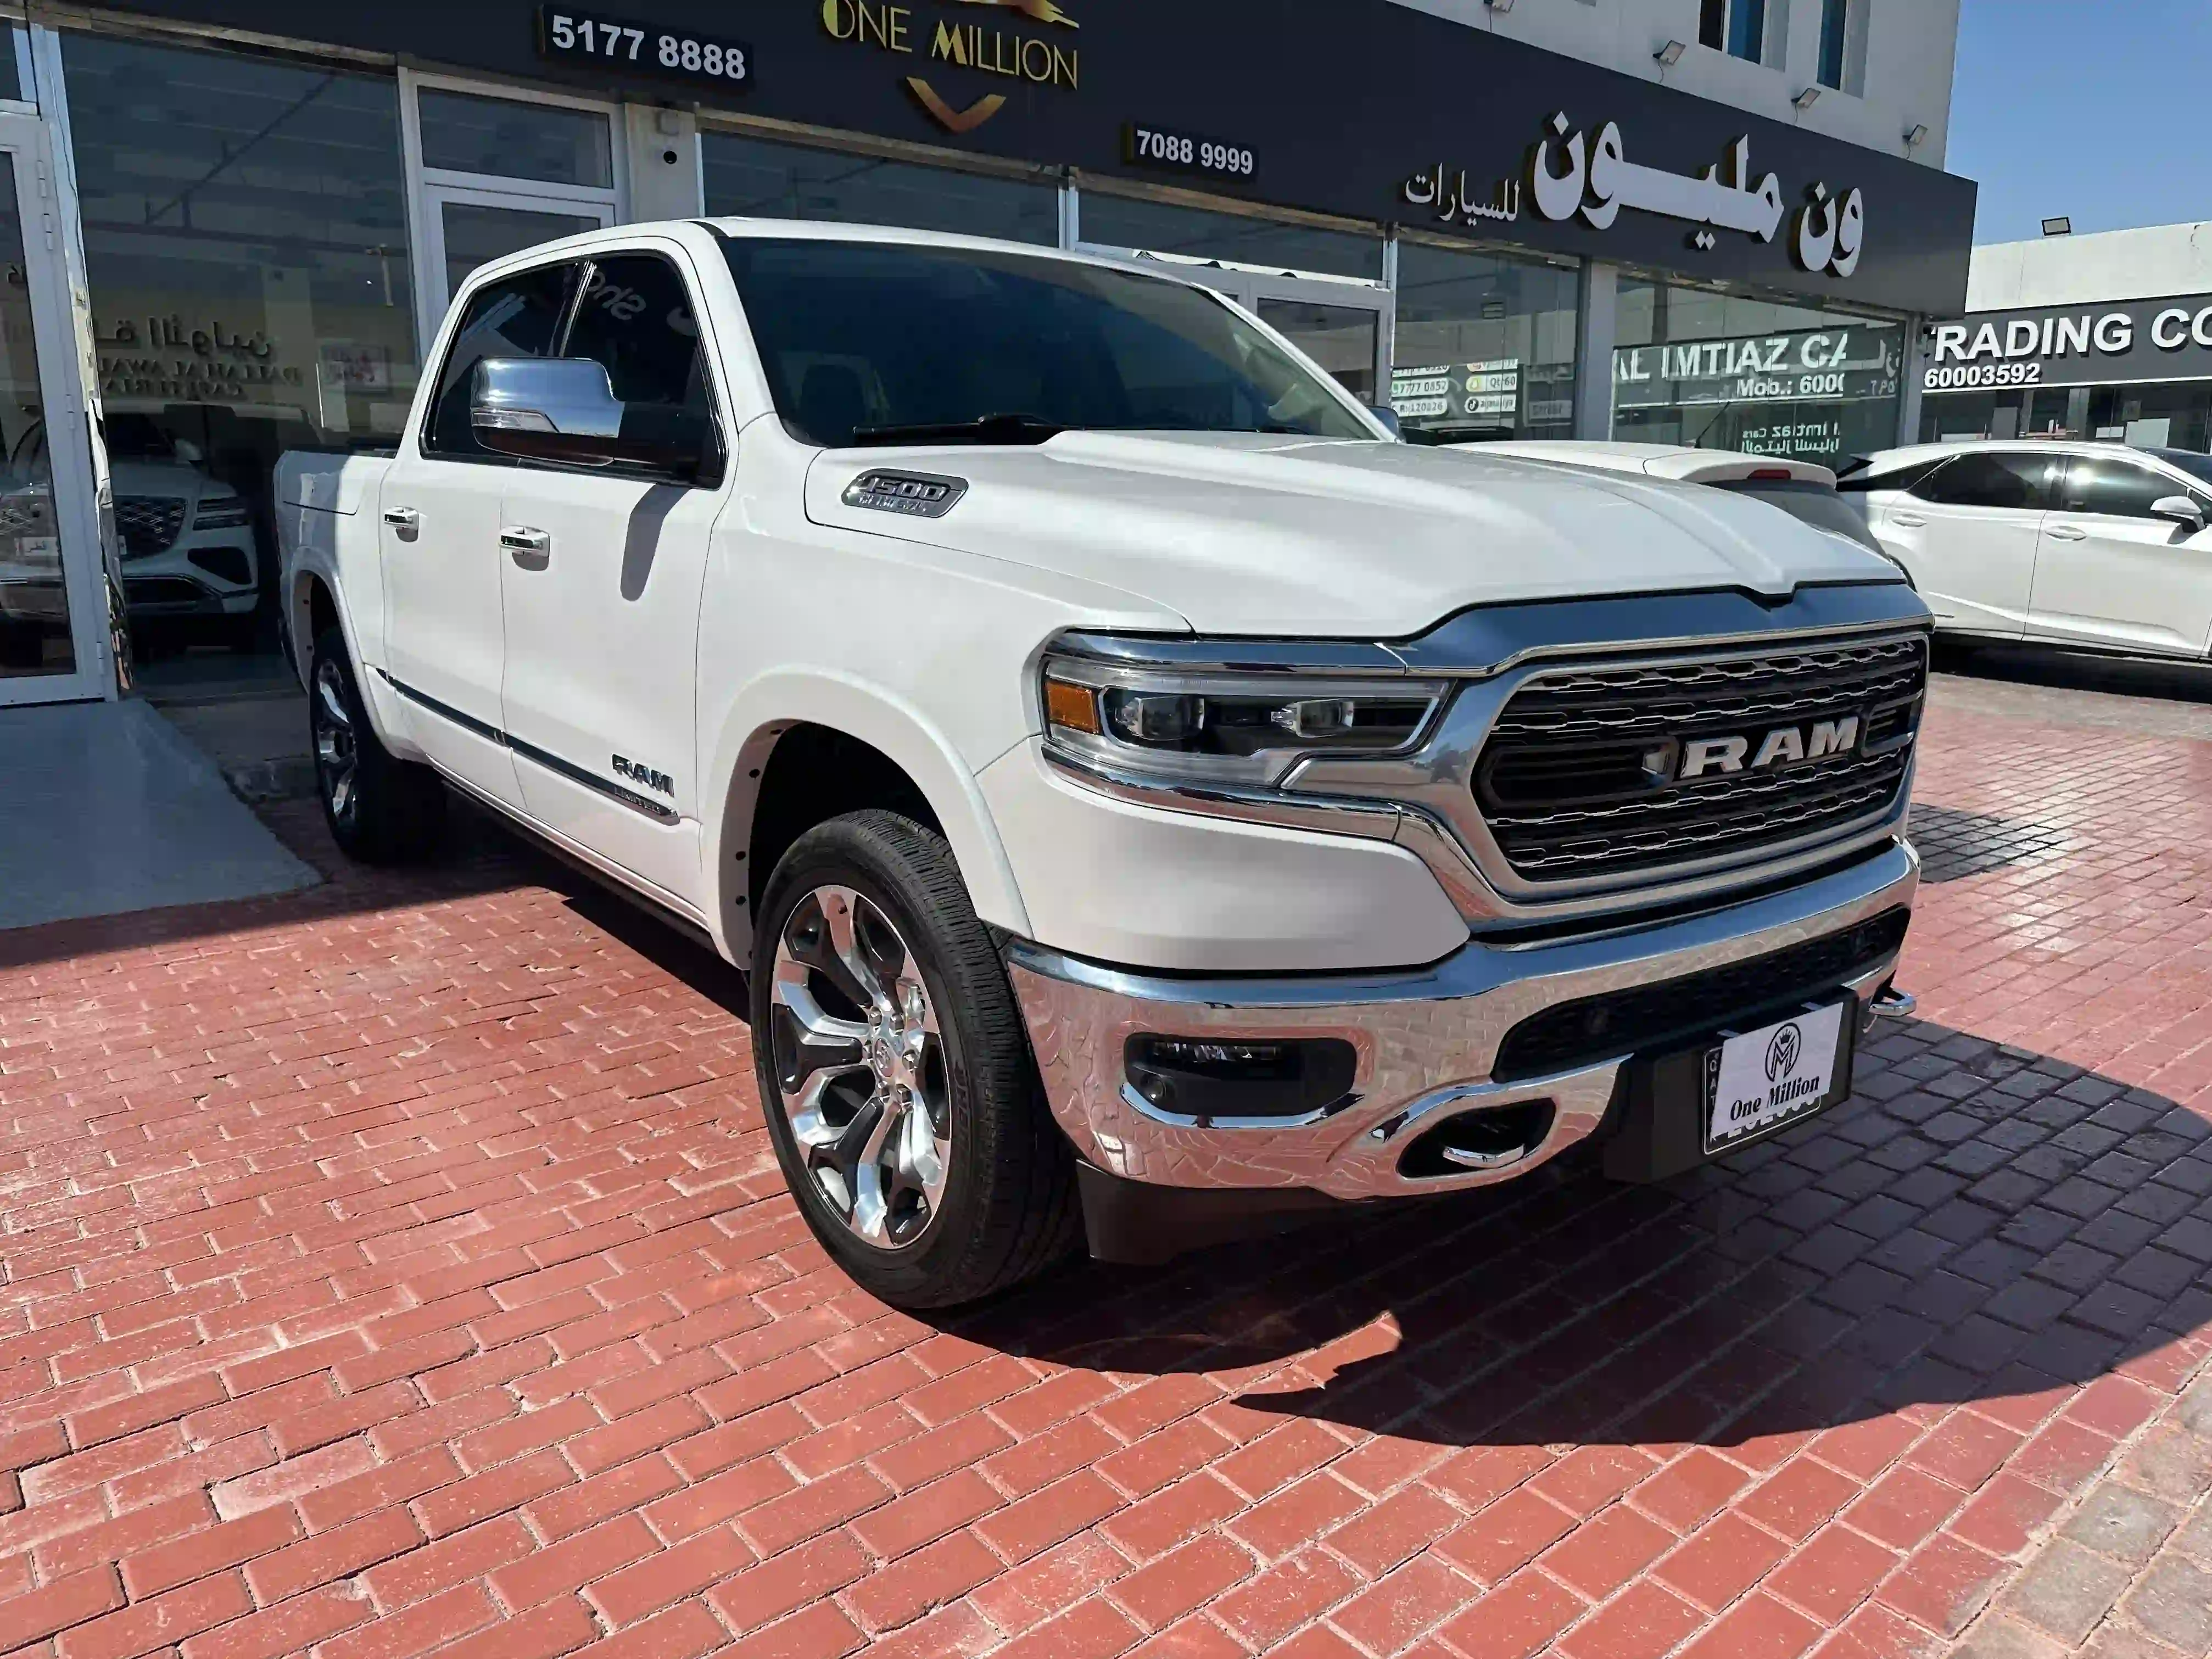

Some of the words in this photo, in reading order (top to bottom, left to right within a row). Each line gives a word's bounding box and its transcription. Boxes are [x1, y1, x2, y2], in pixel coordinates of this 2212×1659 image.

[552, 15, 644, 60] 5177
[658, 35, 745, 79] 8888
[823, 0, 912, 53] ONE
[931, 19, 1077, 91] MILLION
[1137, 130, 1193, 163] 7088
[1200, 142, 1253, 175] 9999
[1534, 111, 1785, 250] مليون
[1405, 163, 1520, 226] للسيارات
[1799, 181, 1863, 277] ون
[1661, 338, 1790, 378] IMTIAZ
[1930, 312, 2132, 362] RADING
[1924, 362, 2041, 388] 60003592
[612, 753, 675, 798] RAM
[1680, 716, 1859, 779] RAM
[1730, 1096, 1762, 1121] One
[1766, 1076, 1820, 1109] Million
